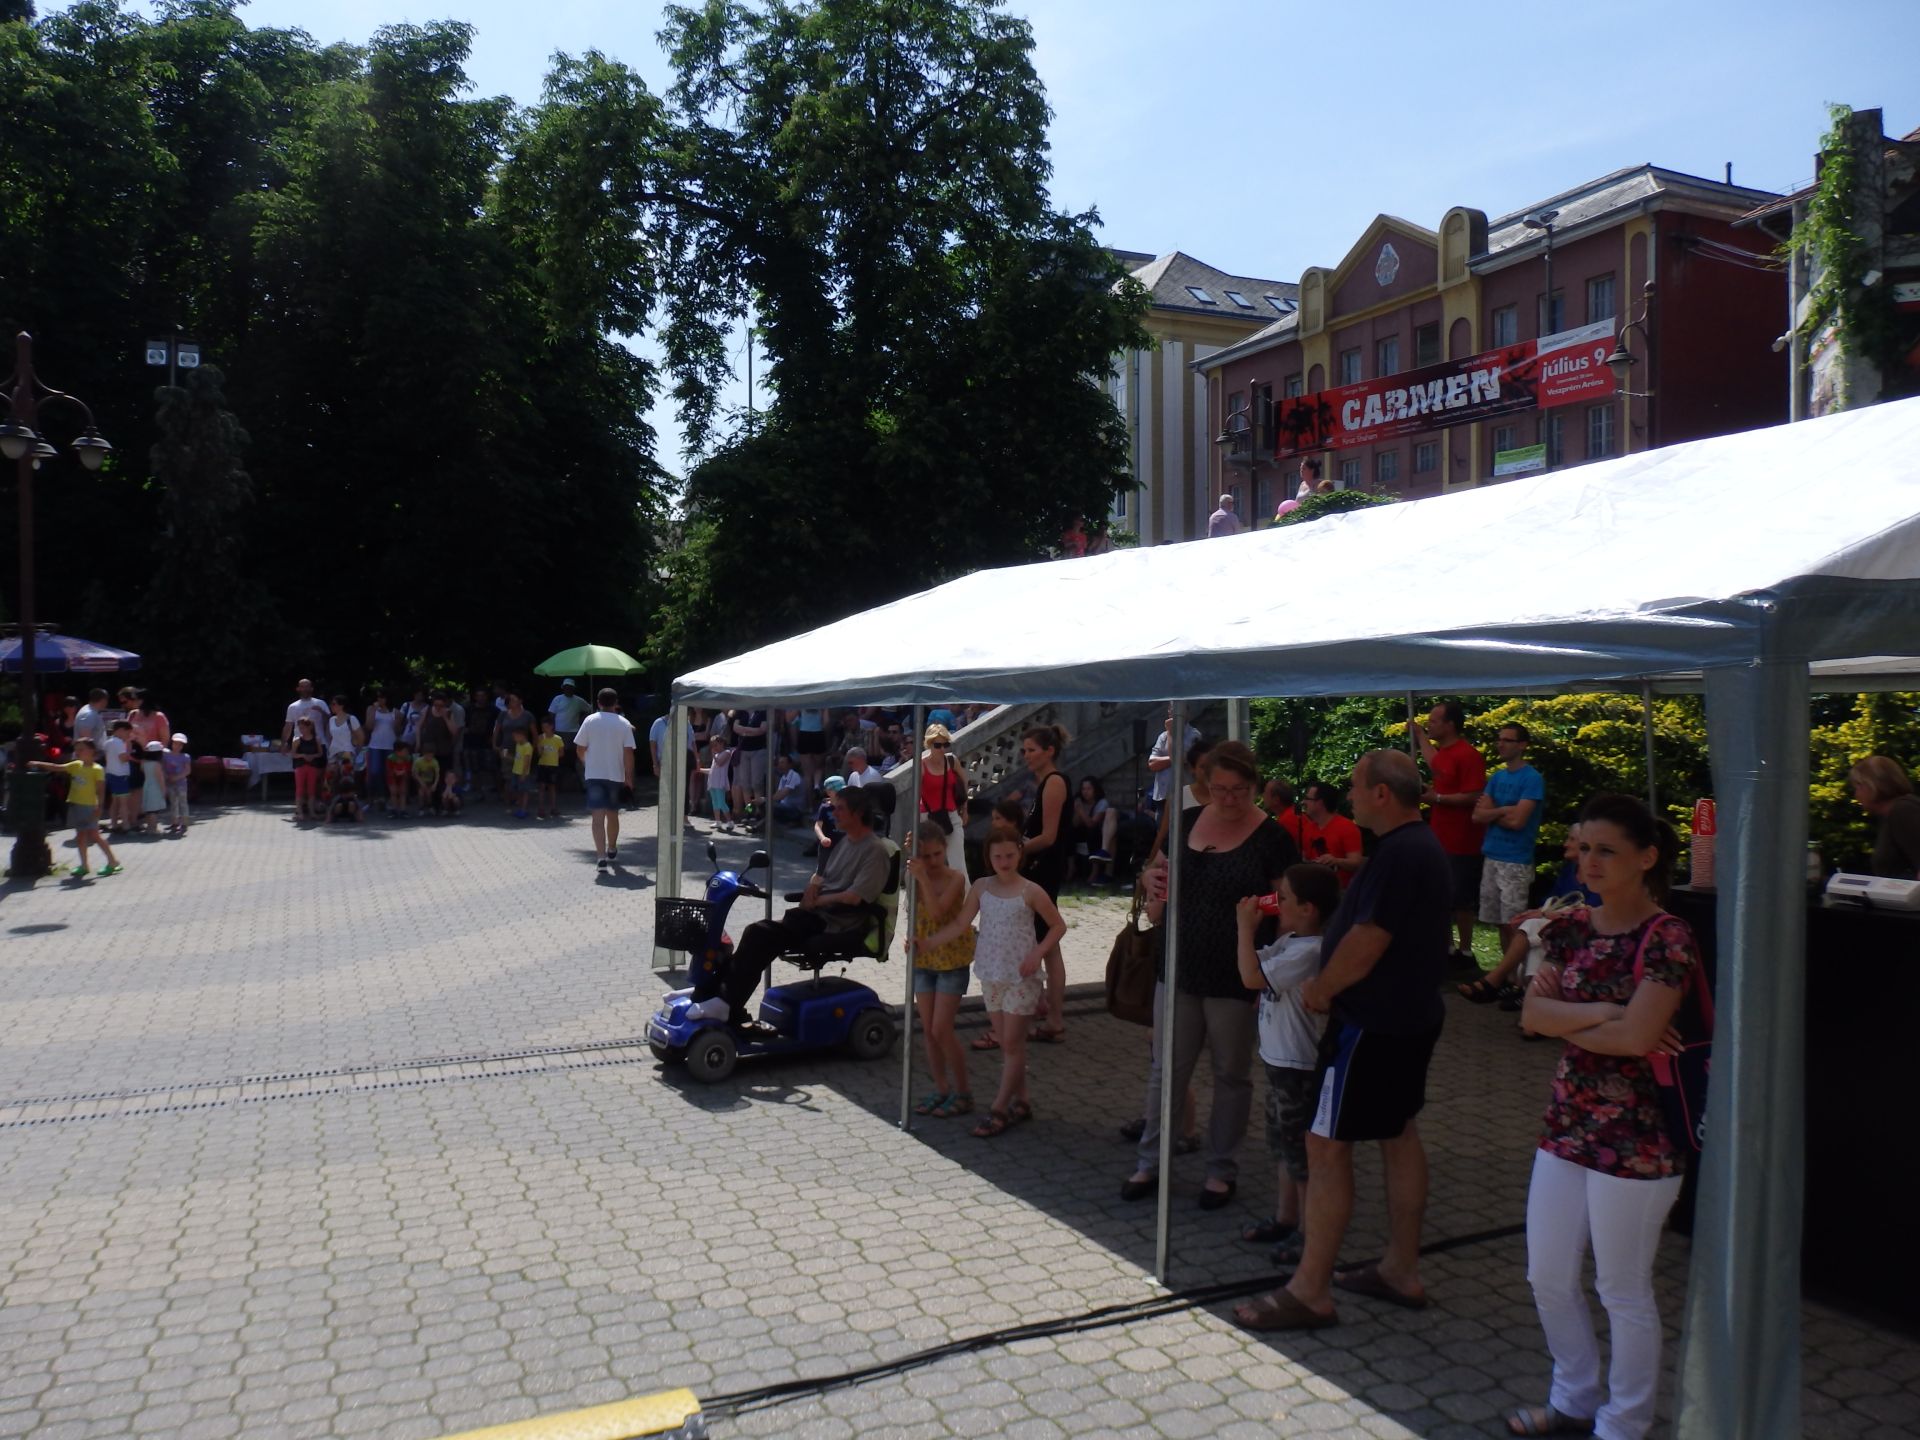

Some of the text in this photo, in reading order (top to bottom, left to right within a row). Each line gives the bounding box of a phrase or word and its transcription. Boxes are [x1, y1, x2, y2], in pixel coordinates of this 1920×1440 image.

[1542, 356, 1589, 384] július
[1594, 347, 1606, 366] 9
[1342, 366, 1501, 430] CARMEN
